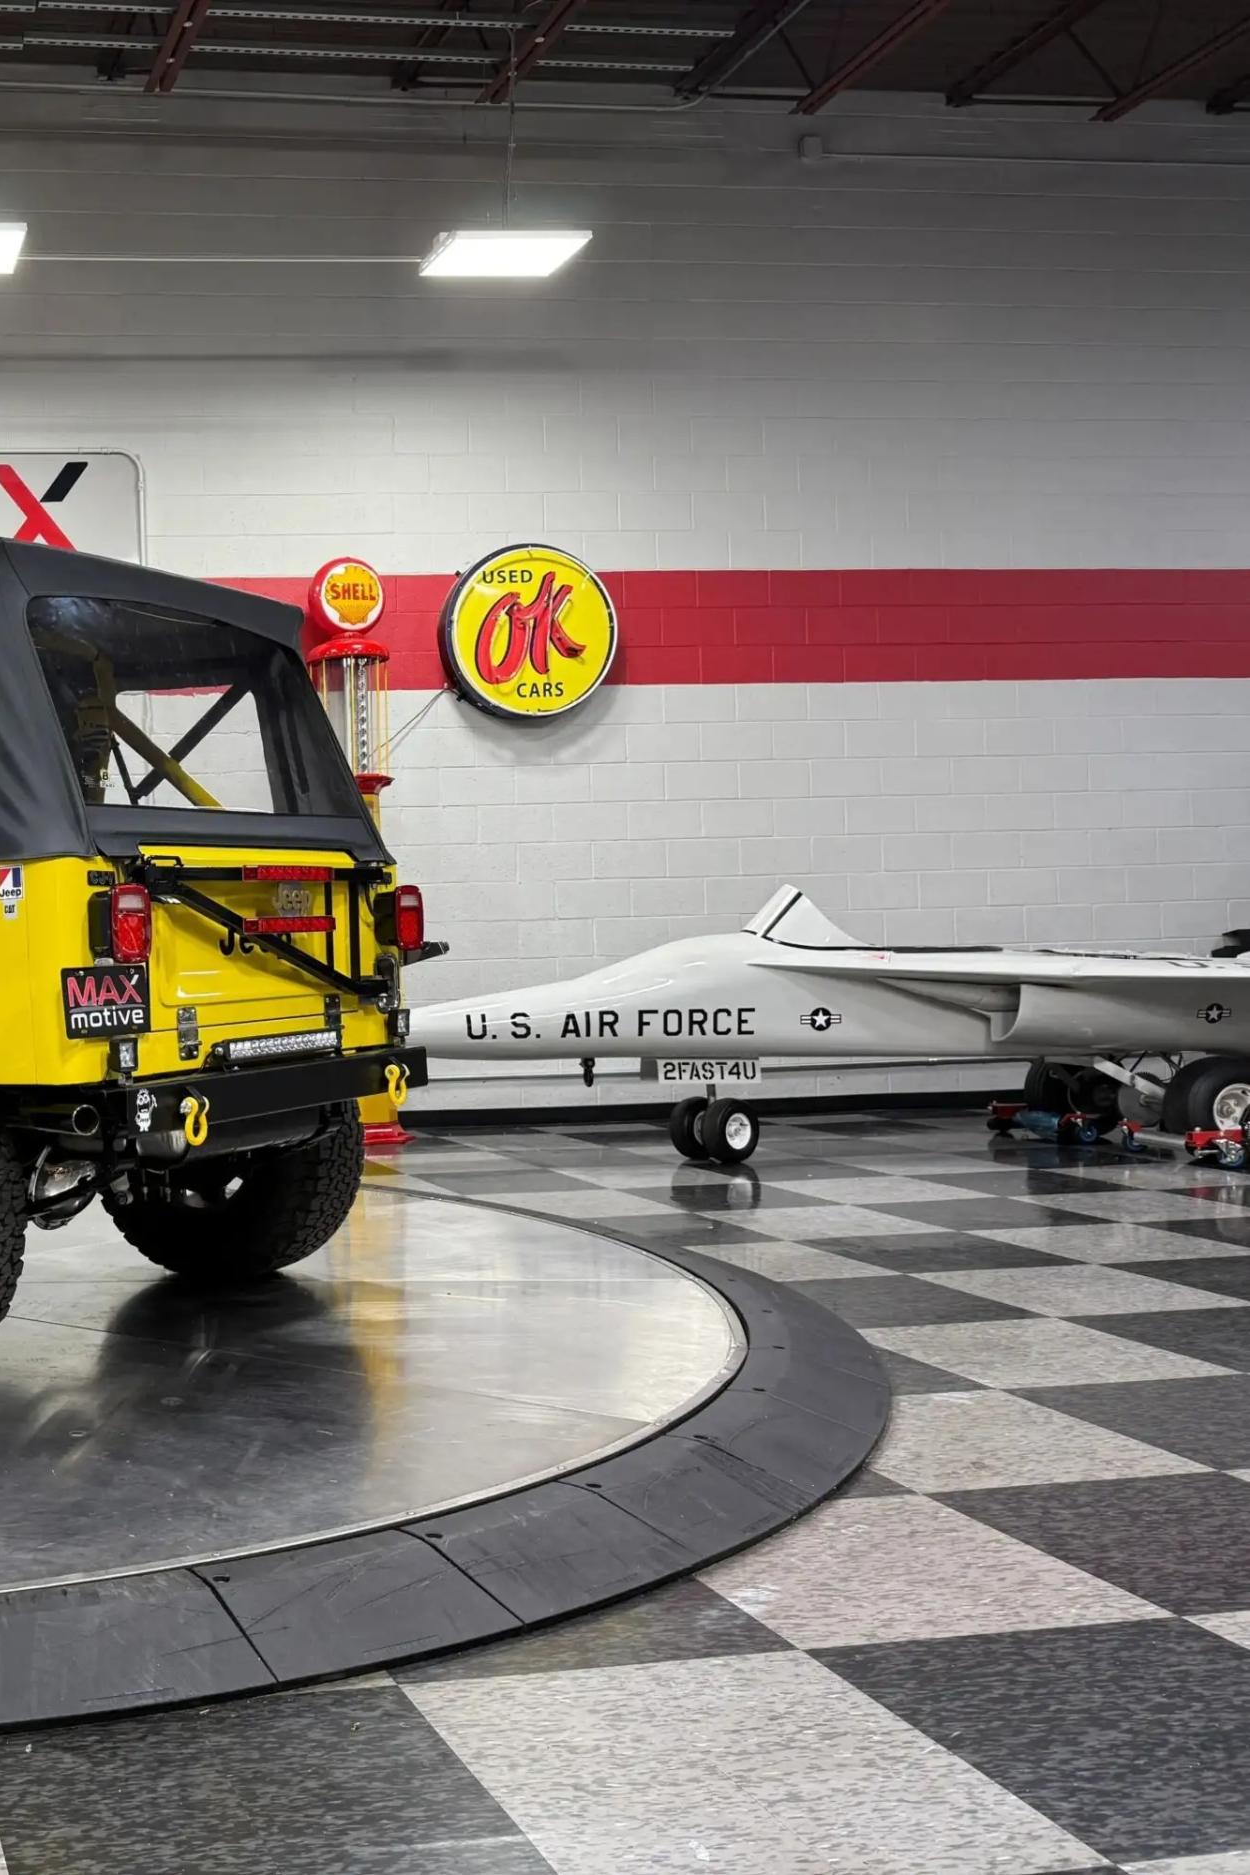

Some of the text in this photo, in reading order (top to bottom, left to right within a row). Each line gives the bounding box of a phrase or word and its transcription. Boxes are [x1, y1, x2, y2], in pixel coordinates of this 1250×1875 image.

[482, 569, 533, 584] USED
[330, 582, 377, 601] SHELL
[516, 682, 564, 698] CARS
[0, 889, 22, 898] Jeep
[67, 974, 143, 1008] MAX
[71, 1008, 144, 1029] motive
[466, 1008, 756, 1040] U. S. AIR FORCE
[663, 1061, 757, 1081] 2FAST4U
